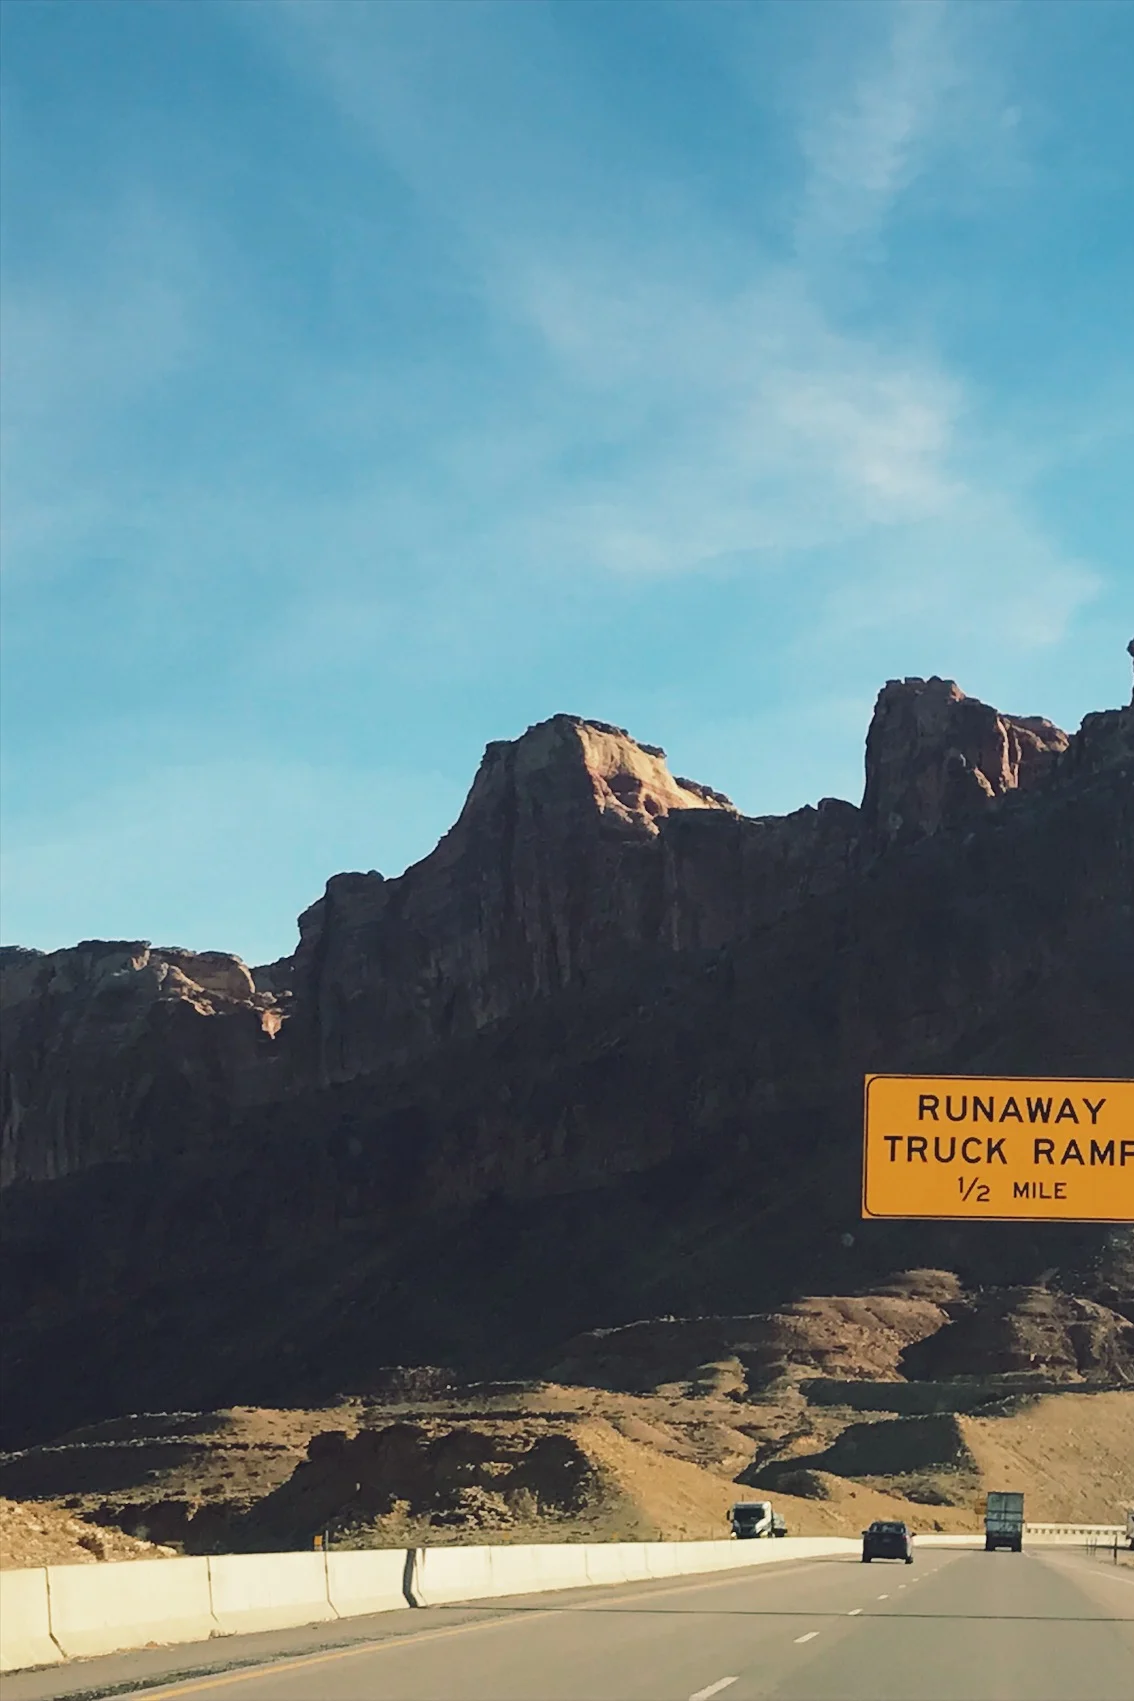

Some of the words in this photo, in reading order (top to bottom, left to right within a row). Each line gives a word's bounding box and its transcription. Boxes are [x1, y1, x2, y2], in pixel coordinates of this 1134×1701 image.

[918, 1094, 1107, 1125] RUNAWAY
[883, 1135, 1008, 1165] TRUCK
[1013, 1181, 1067, 1200] MILE
